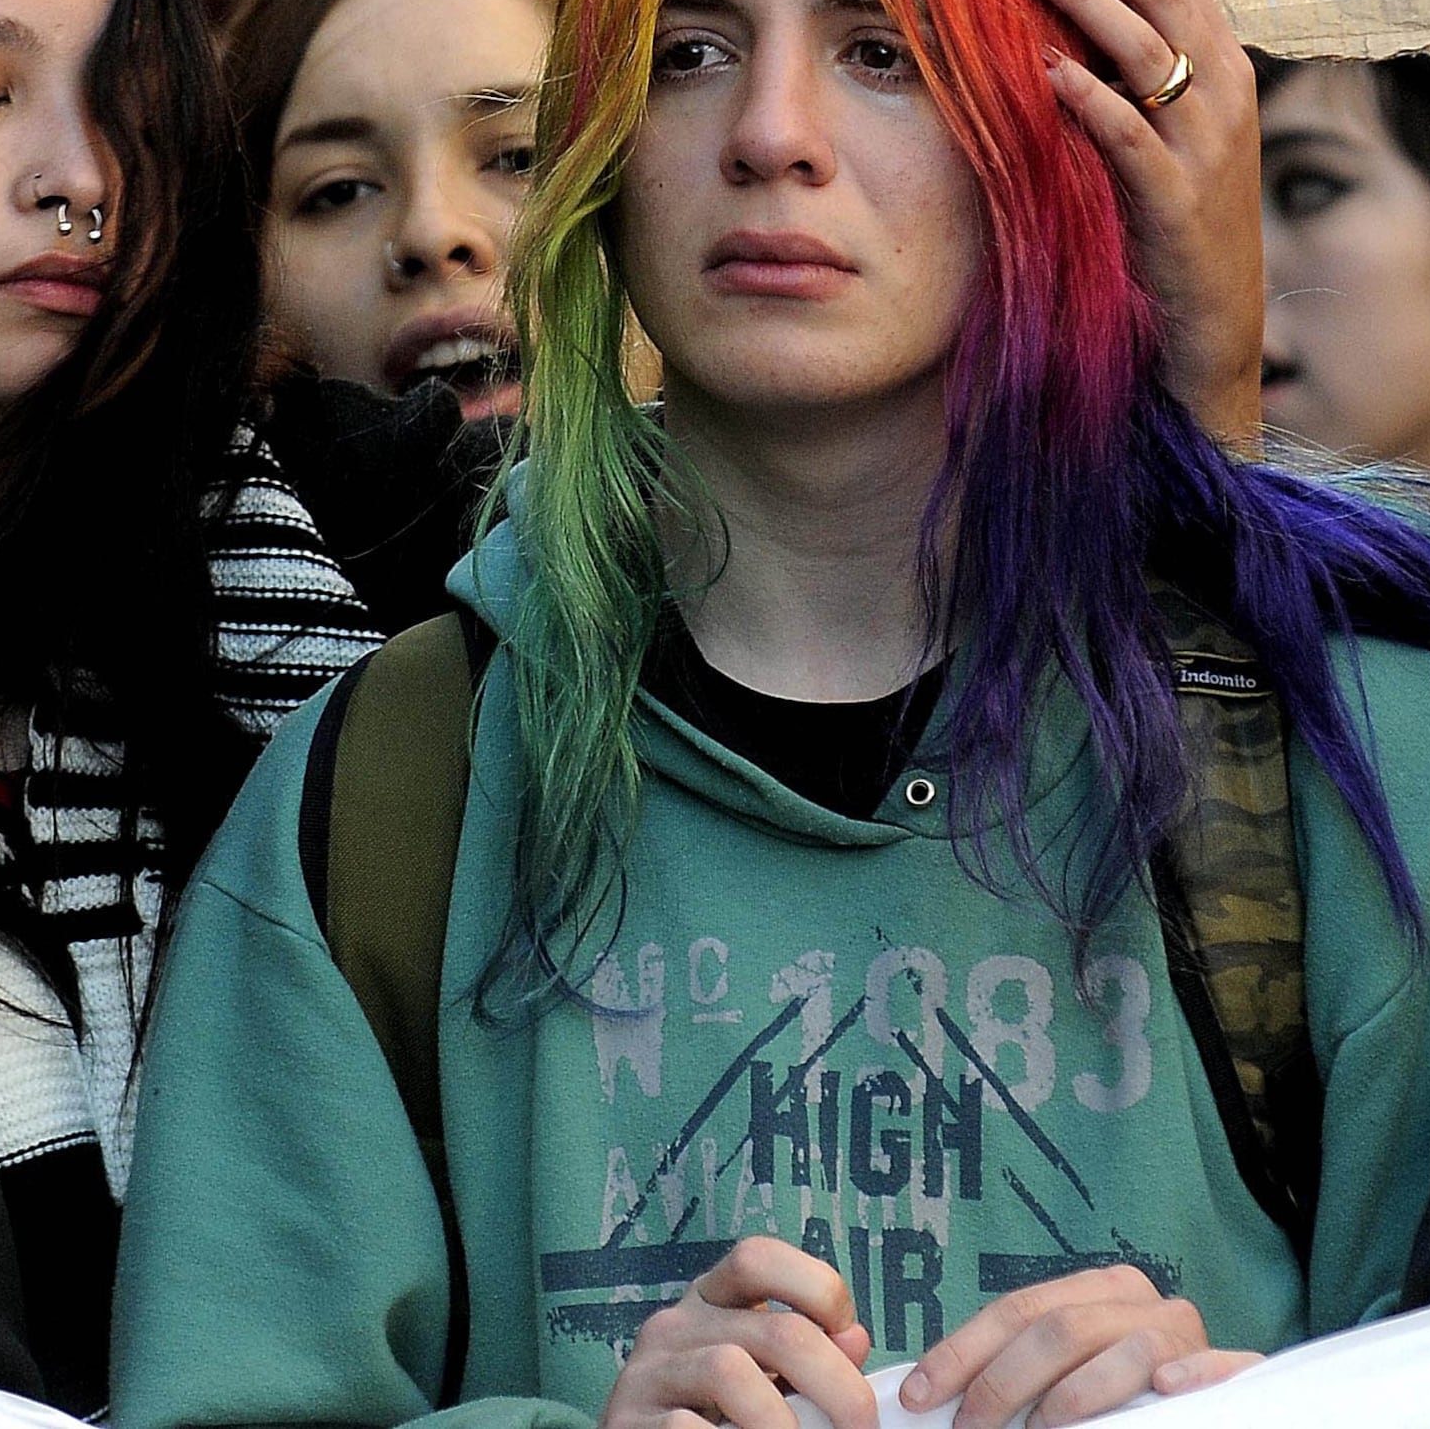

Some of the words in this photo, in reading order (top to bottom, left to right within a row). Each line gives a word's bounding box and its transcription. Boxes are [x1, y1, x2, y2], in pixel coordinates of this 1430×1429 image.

[1179, 669, 1257, 690] Indomito
[770, 943, 1153, 1114] 1983
[748, 1059, 985, 1202] HIGH
